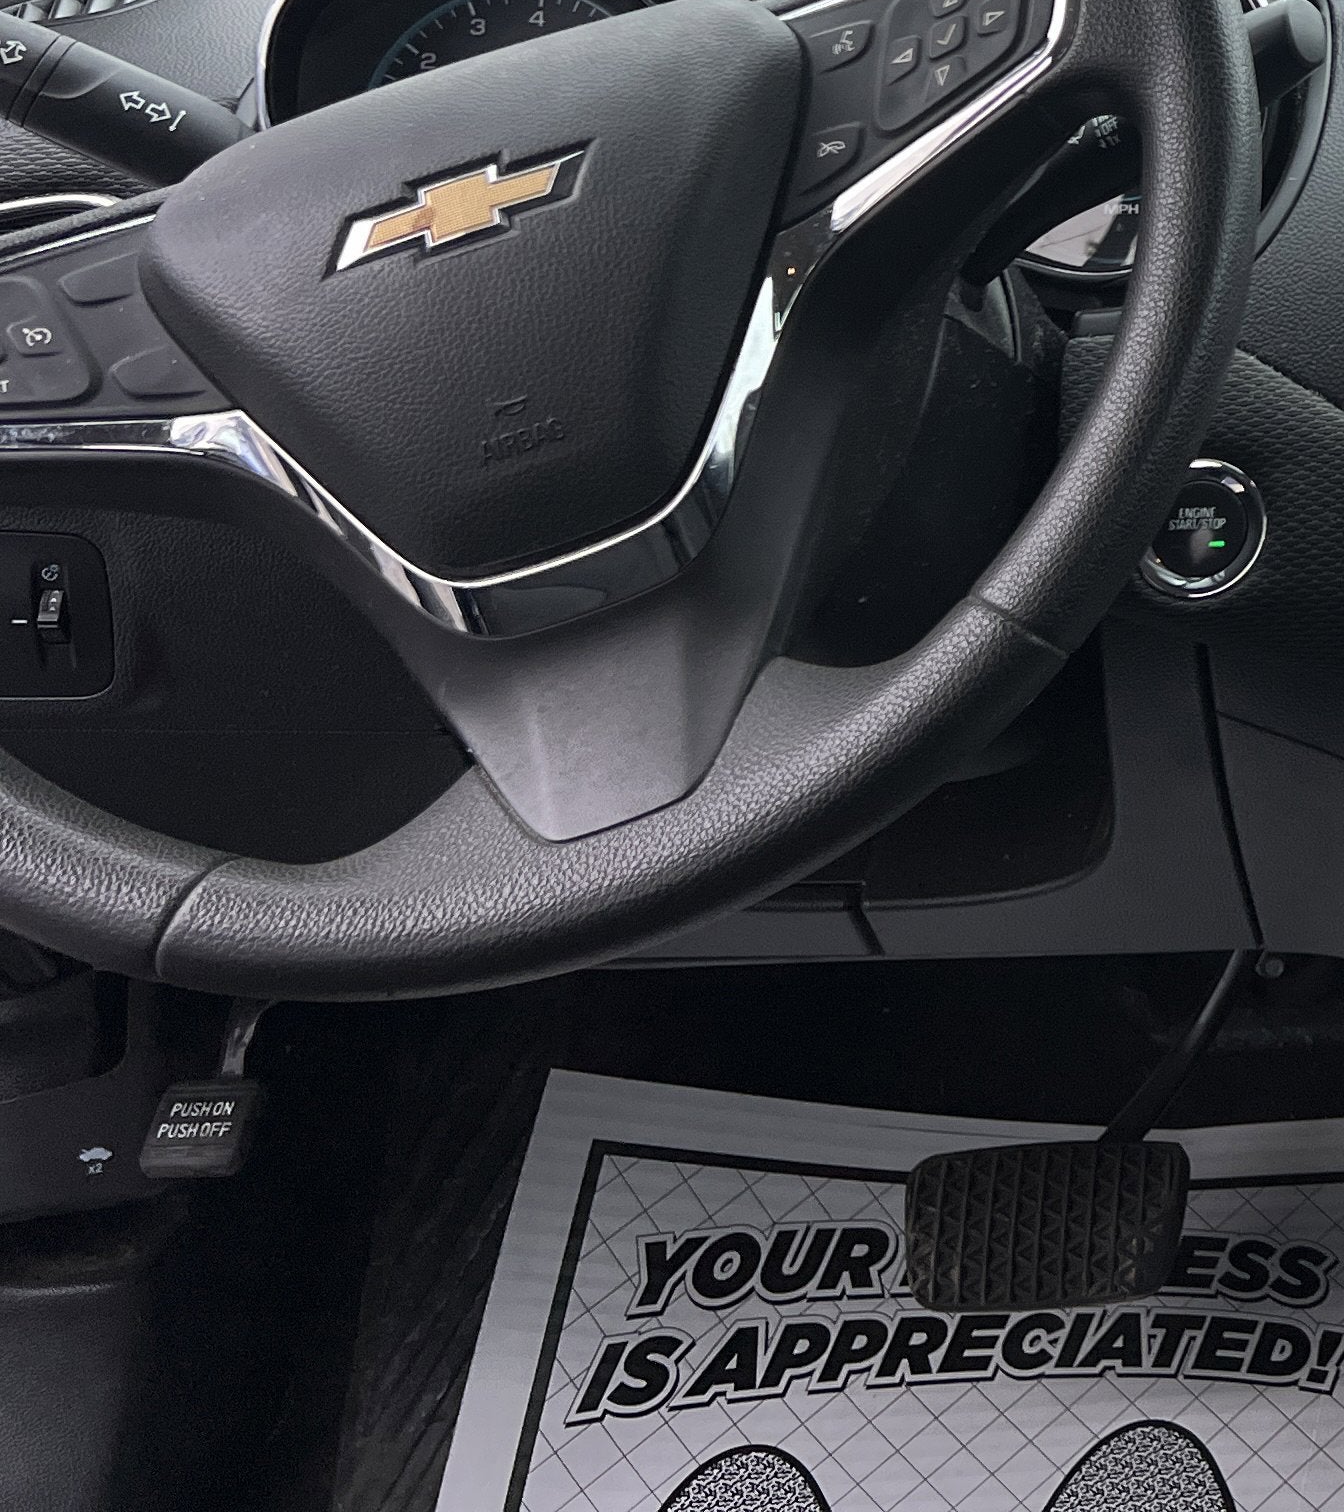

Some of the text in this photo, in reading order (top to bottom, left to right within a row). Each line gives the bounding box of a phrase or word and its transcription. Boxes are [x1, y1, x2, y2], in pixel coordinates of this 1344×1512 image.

[528, 10, 546, 27] 4
[469, 18, 486, 36] 3
[420, 52, 437, 70] 2
[1103, 203, 1140, 215] MPH
[1178, 507, 1216, 519] ENGINE
[1168, 518, 1227, 530] START/STOP
[170, 1101, 235, 1117] PUSH ON
[157, 1122, 232, 1138] PUSH OFF
[633, 1225, 893, 1309] YOUR
[573, 1333, 687, 1416] IS
